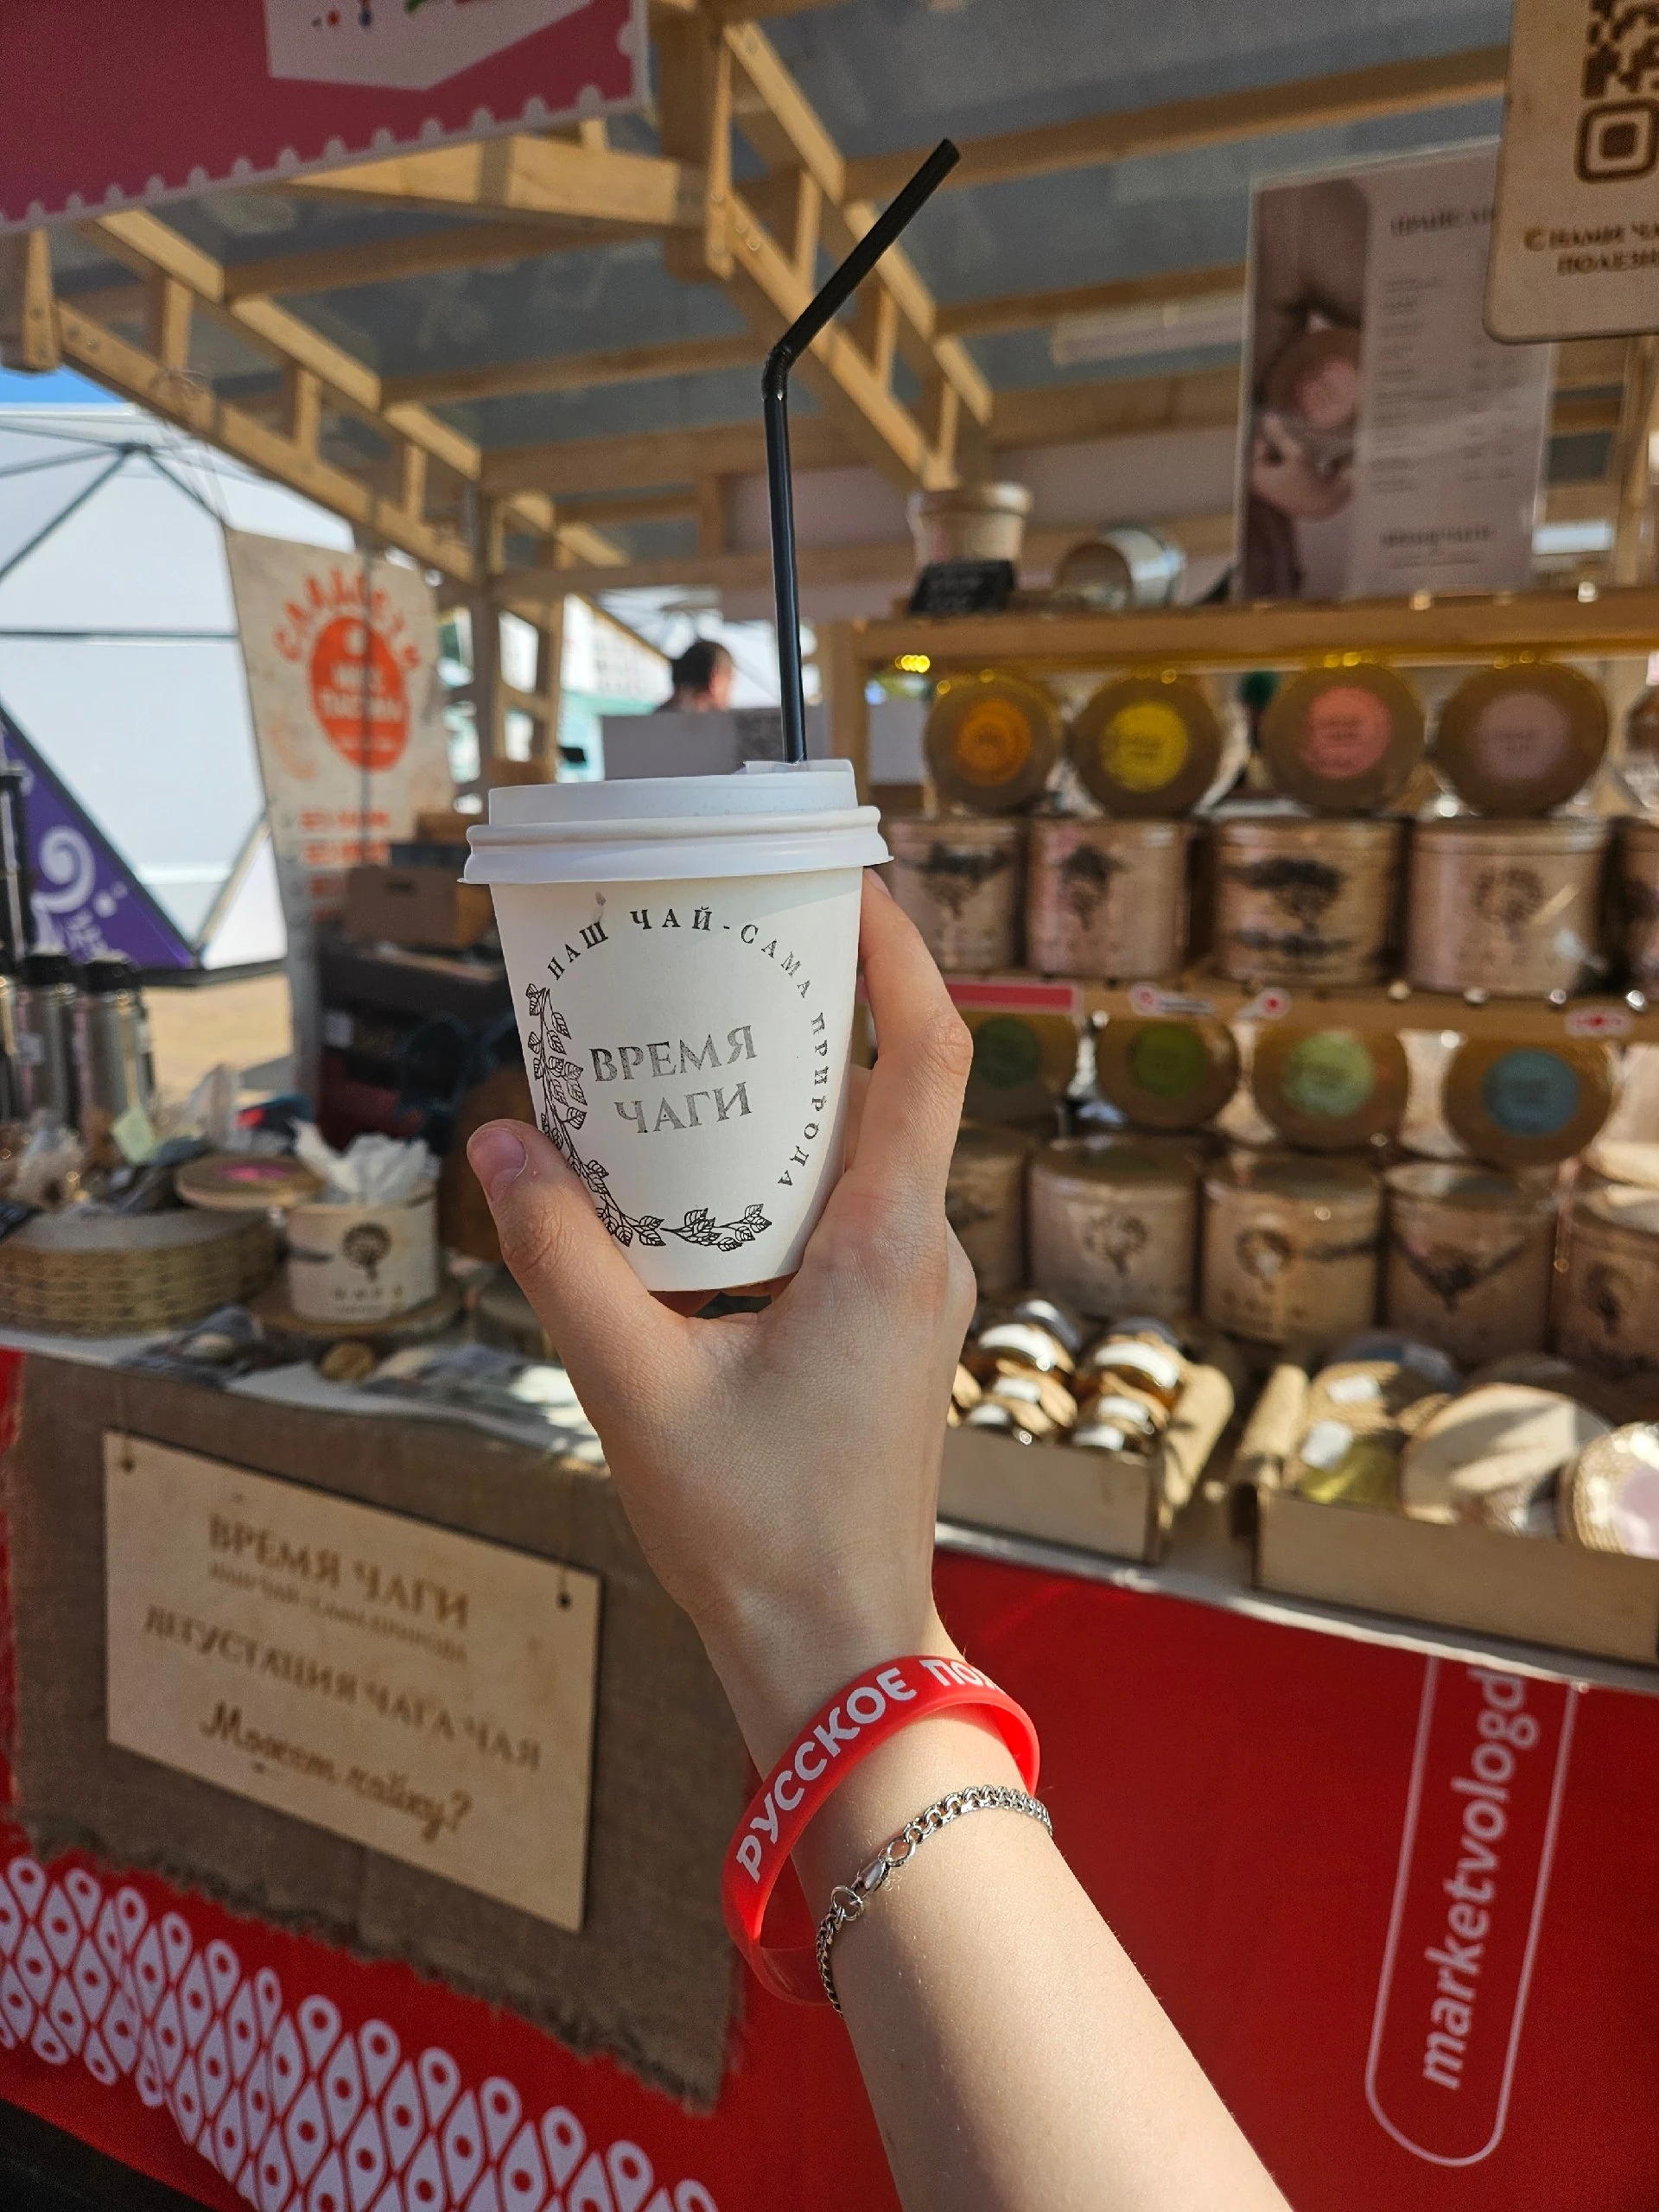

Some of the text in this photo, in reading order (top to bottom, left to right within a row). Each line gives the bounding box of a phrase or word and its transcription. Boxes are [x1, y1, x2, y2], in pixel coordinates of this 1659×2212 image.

[547, 921, 609, 980] НАШ
[777, 1012, 829, 1187] ПРИРОДА
[588, 1025, 758, 1082] ВРЕМЯ
[613, 1081, 753, 1135] ЧАГИ
[207, 1512, 341, 1591] ВРЕМЯ
[353, 1559, 469, 1630] ЧАГИ
[735, 1667, 917, 1884] РУССКОЕ
